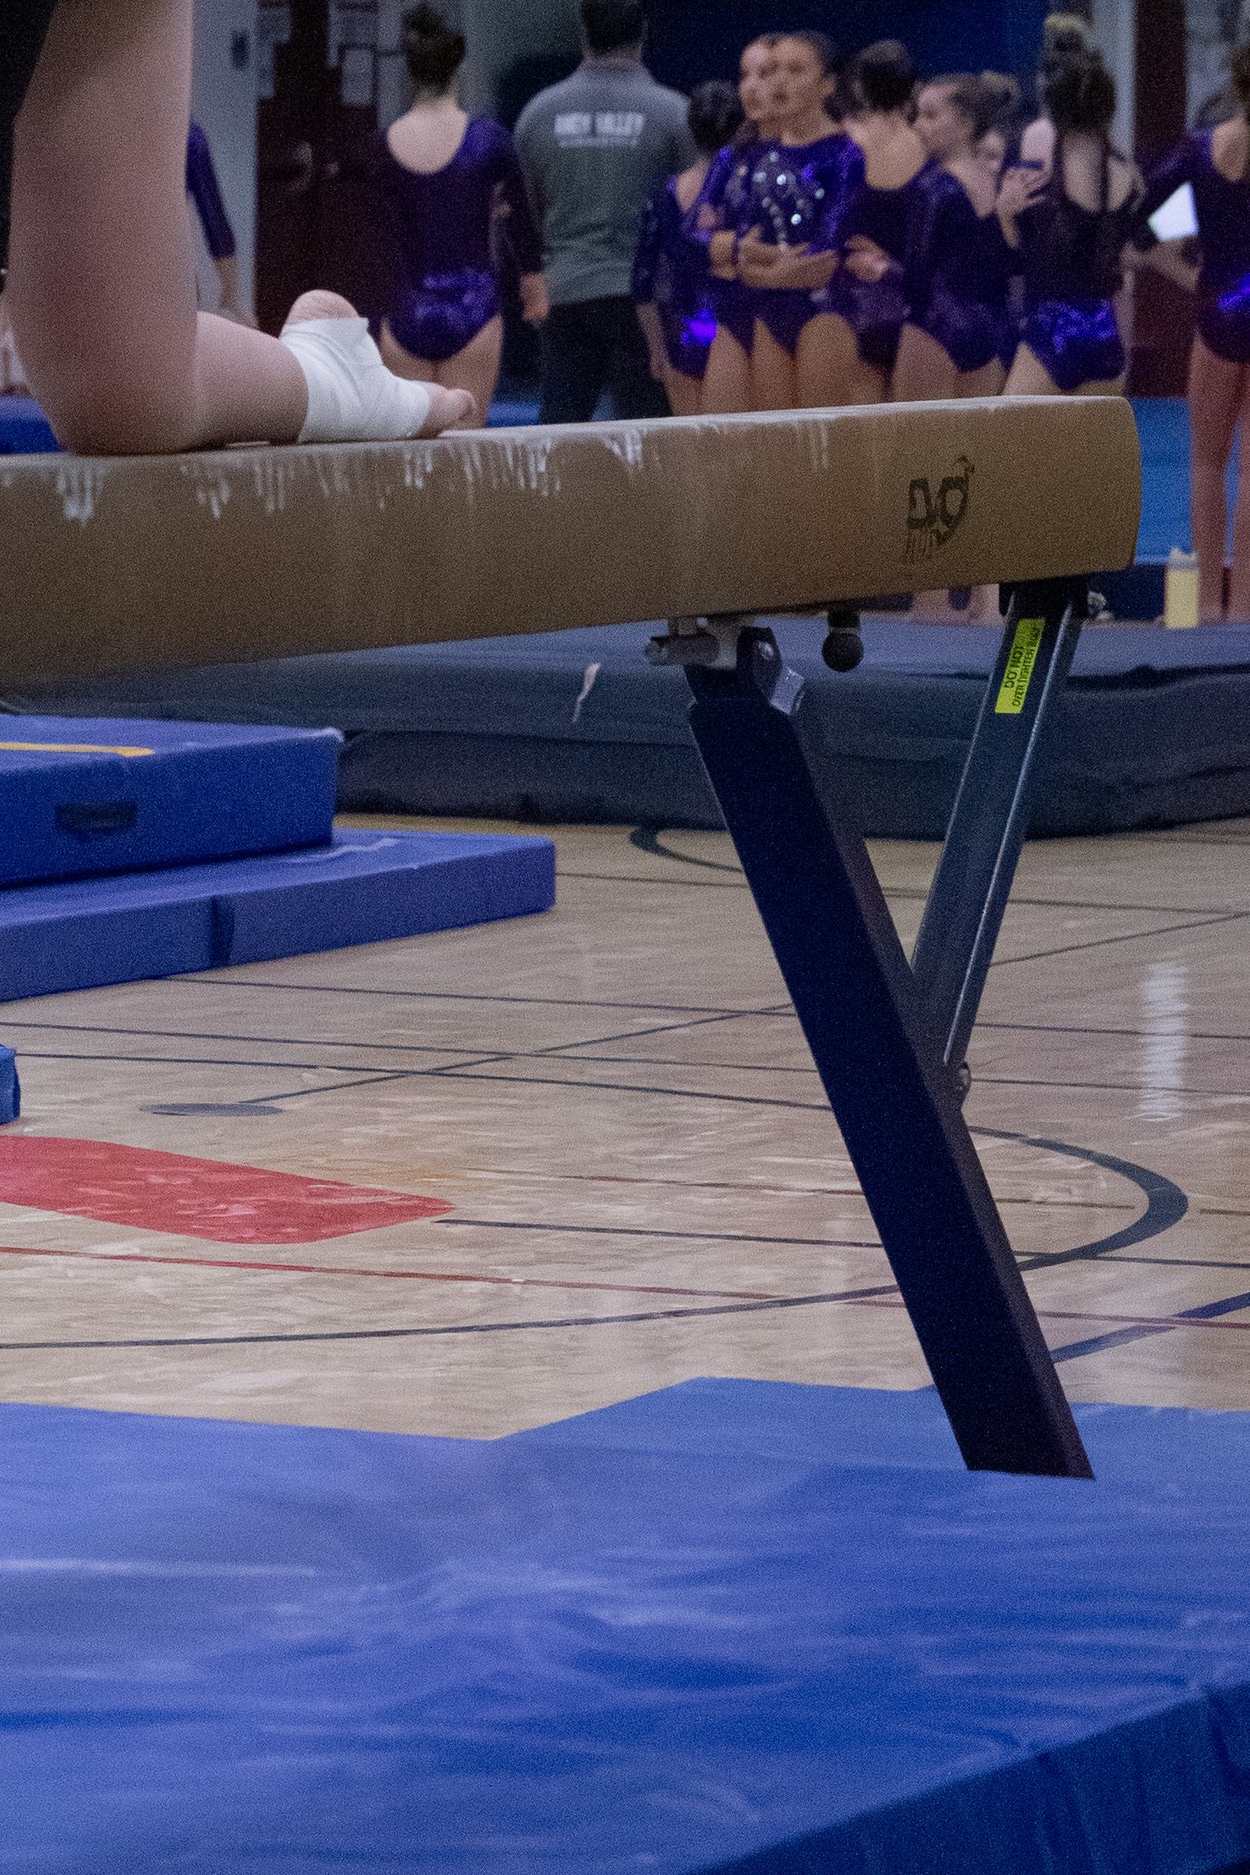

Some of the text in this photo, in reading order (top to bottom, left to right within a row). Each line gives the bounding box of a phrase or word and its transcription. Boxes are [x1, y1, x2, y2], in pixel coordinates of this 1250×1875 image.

[1004, 644, 1025, 689] DO NOT
[1011, 684, 1025, 708] OVER
